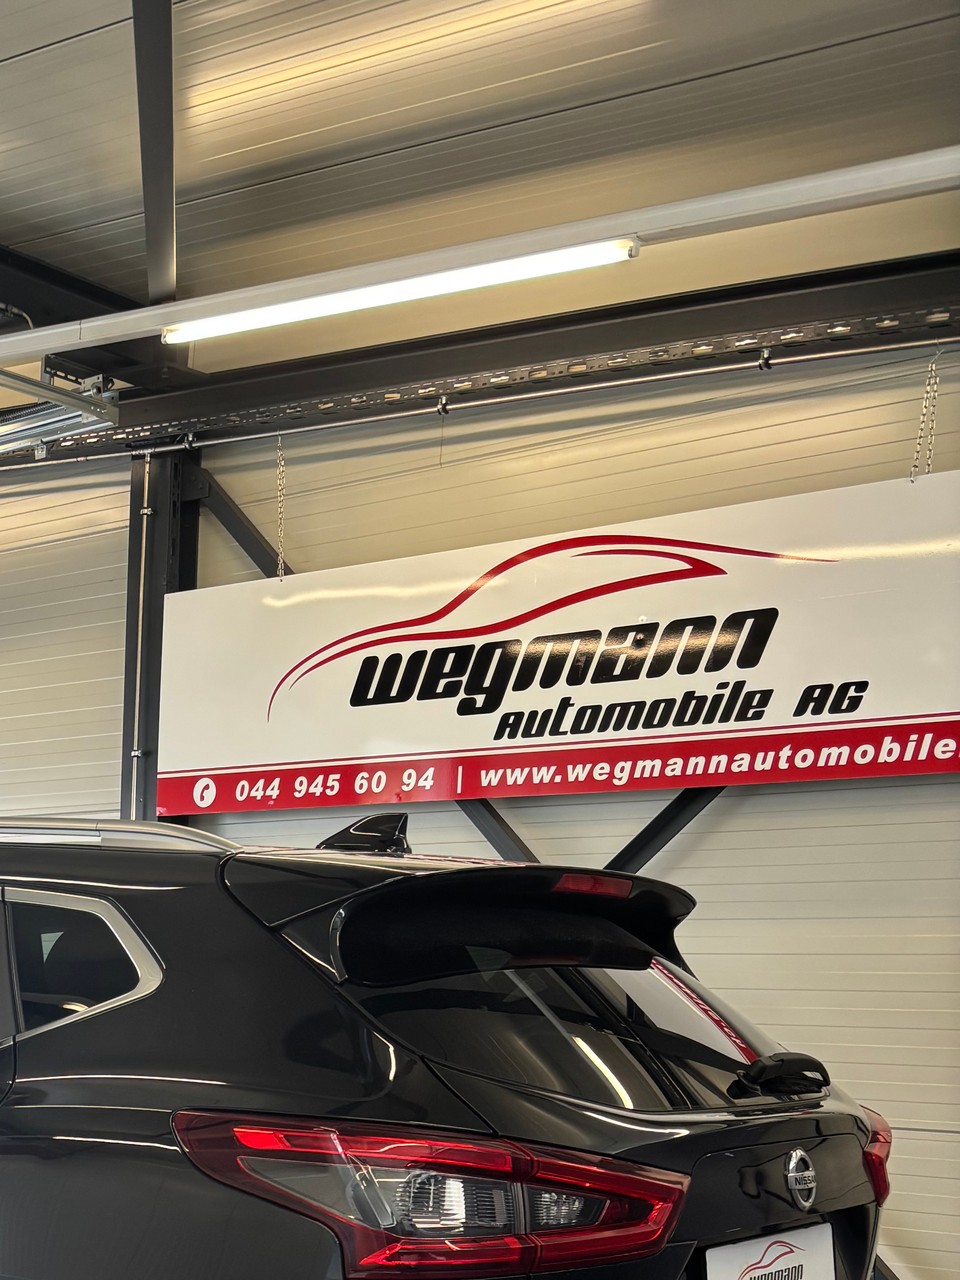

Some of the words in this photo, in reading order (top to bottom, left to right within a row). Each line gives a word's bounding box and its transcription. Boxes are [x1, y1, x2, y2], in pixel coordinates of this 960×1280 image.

[350, 607, 779, 716] wegmann
[493, 680, 774, 740] automobile
[793, 680, 869, 718] AG
[235, 777, 280, 801] 044
[293, 774, 340, 798] 945
[354, 771, 386, 795] 60
[401, 767, 435, 791] 94
[480, 733, 960, 789] www.wegmannautomobile
